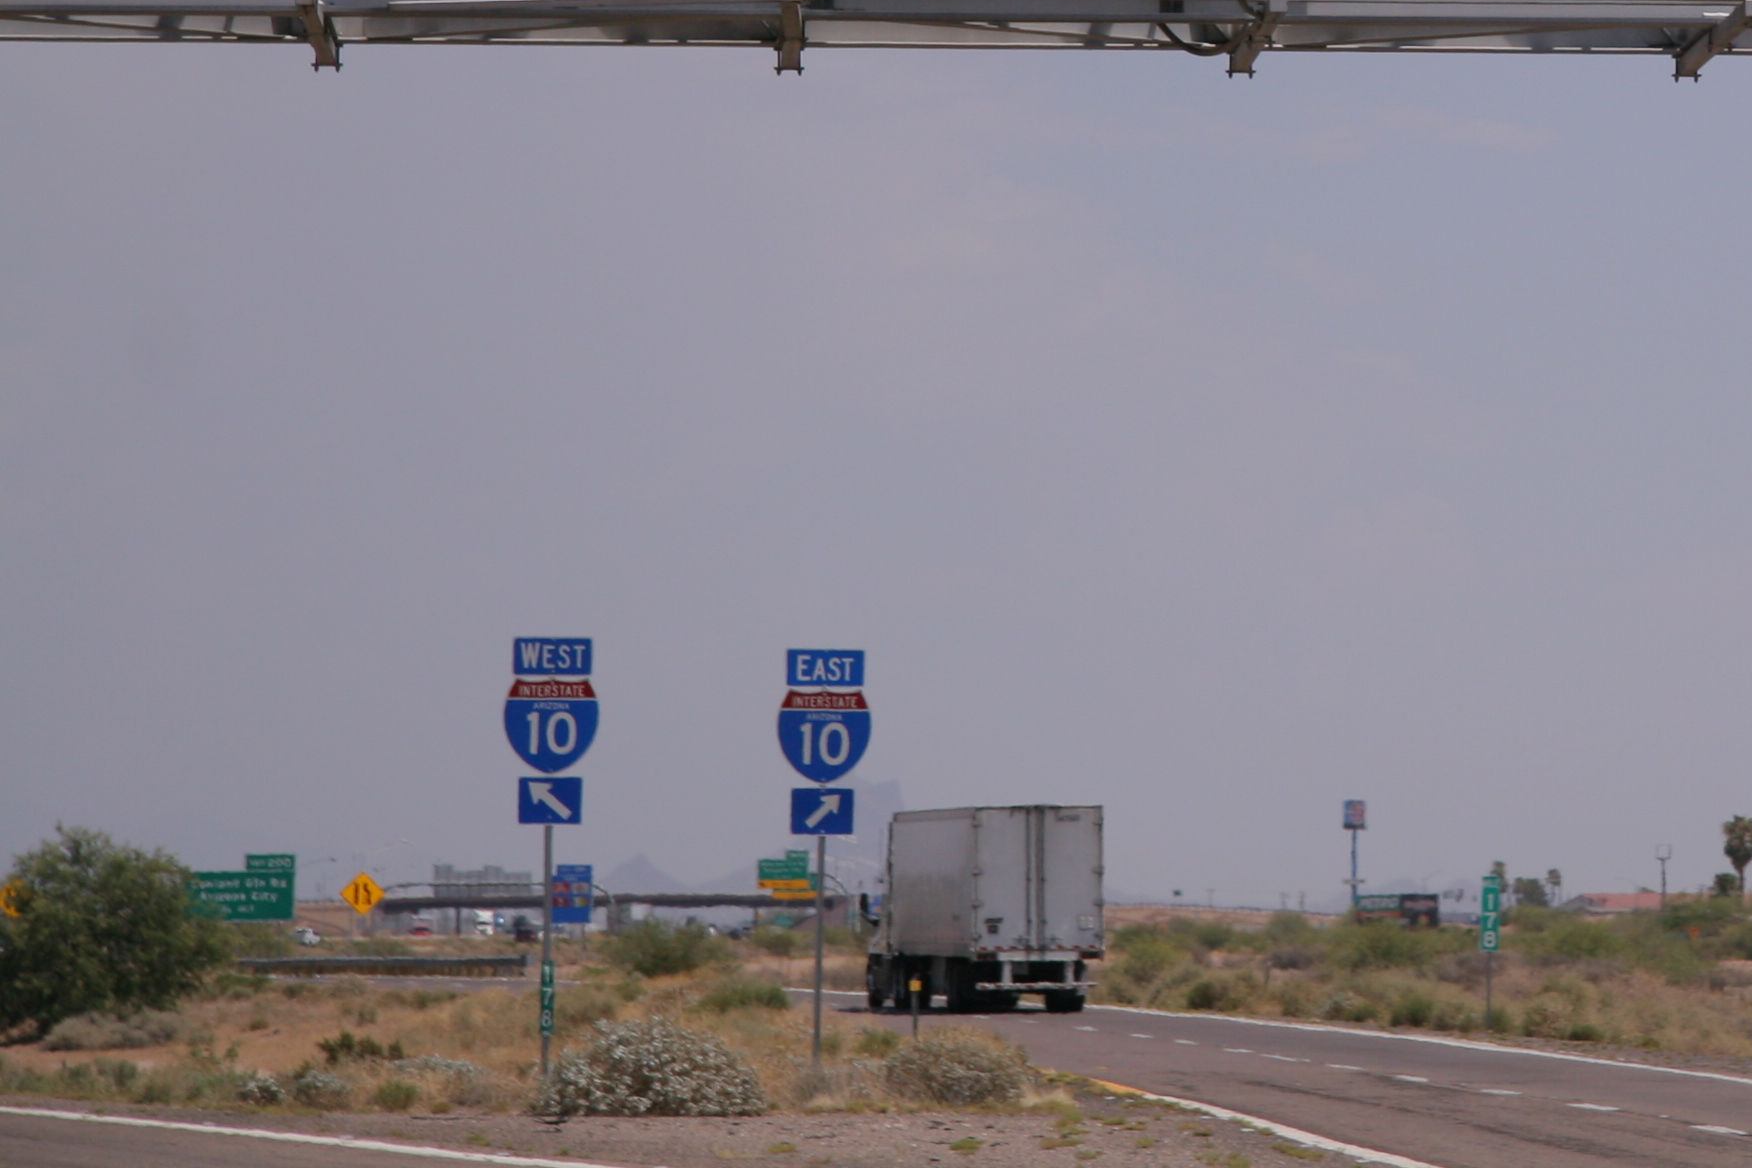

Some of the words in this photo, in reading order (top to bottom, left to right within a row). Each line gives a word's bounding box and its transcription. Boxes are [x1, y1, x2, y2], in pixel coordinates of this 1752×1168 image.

[520, 642, 586, 669] WEST
[796, 655, 855, 682] EAST
[518, 684, 586, 697] INTERSTATE
[791, 695, 858, 708] INTERSTATE
[533, 701, 571, 710] ARIZONA
[526, 711, 578, 755] 10
[800, 722, 851, 766] 10
